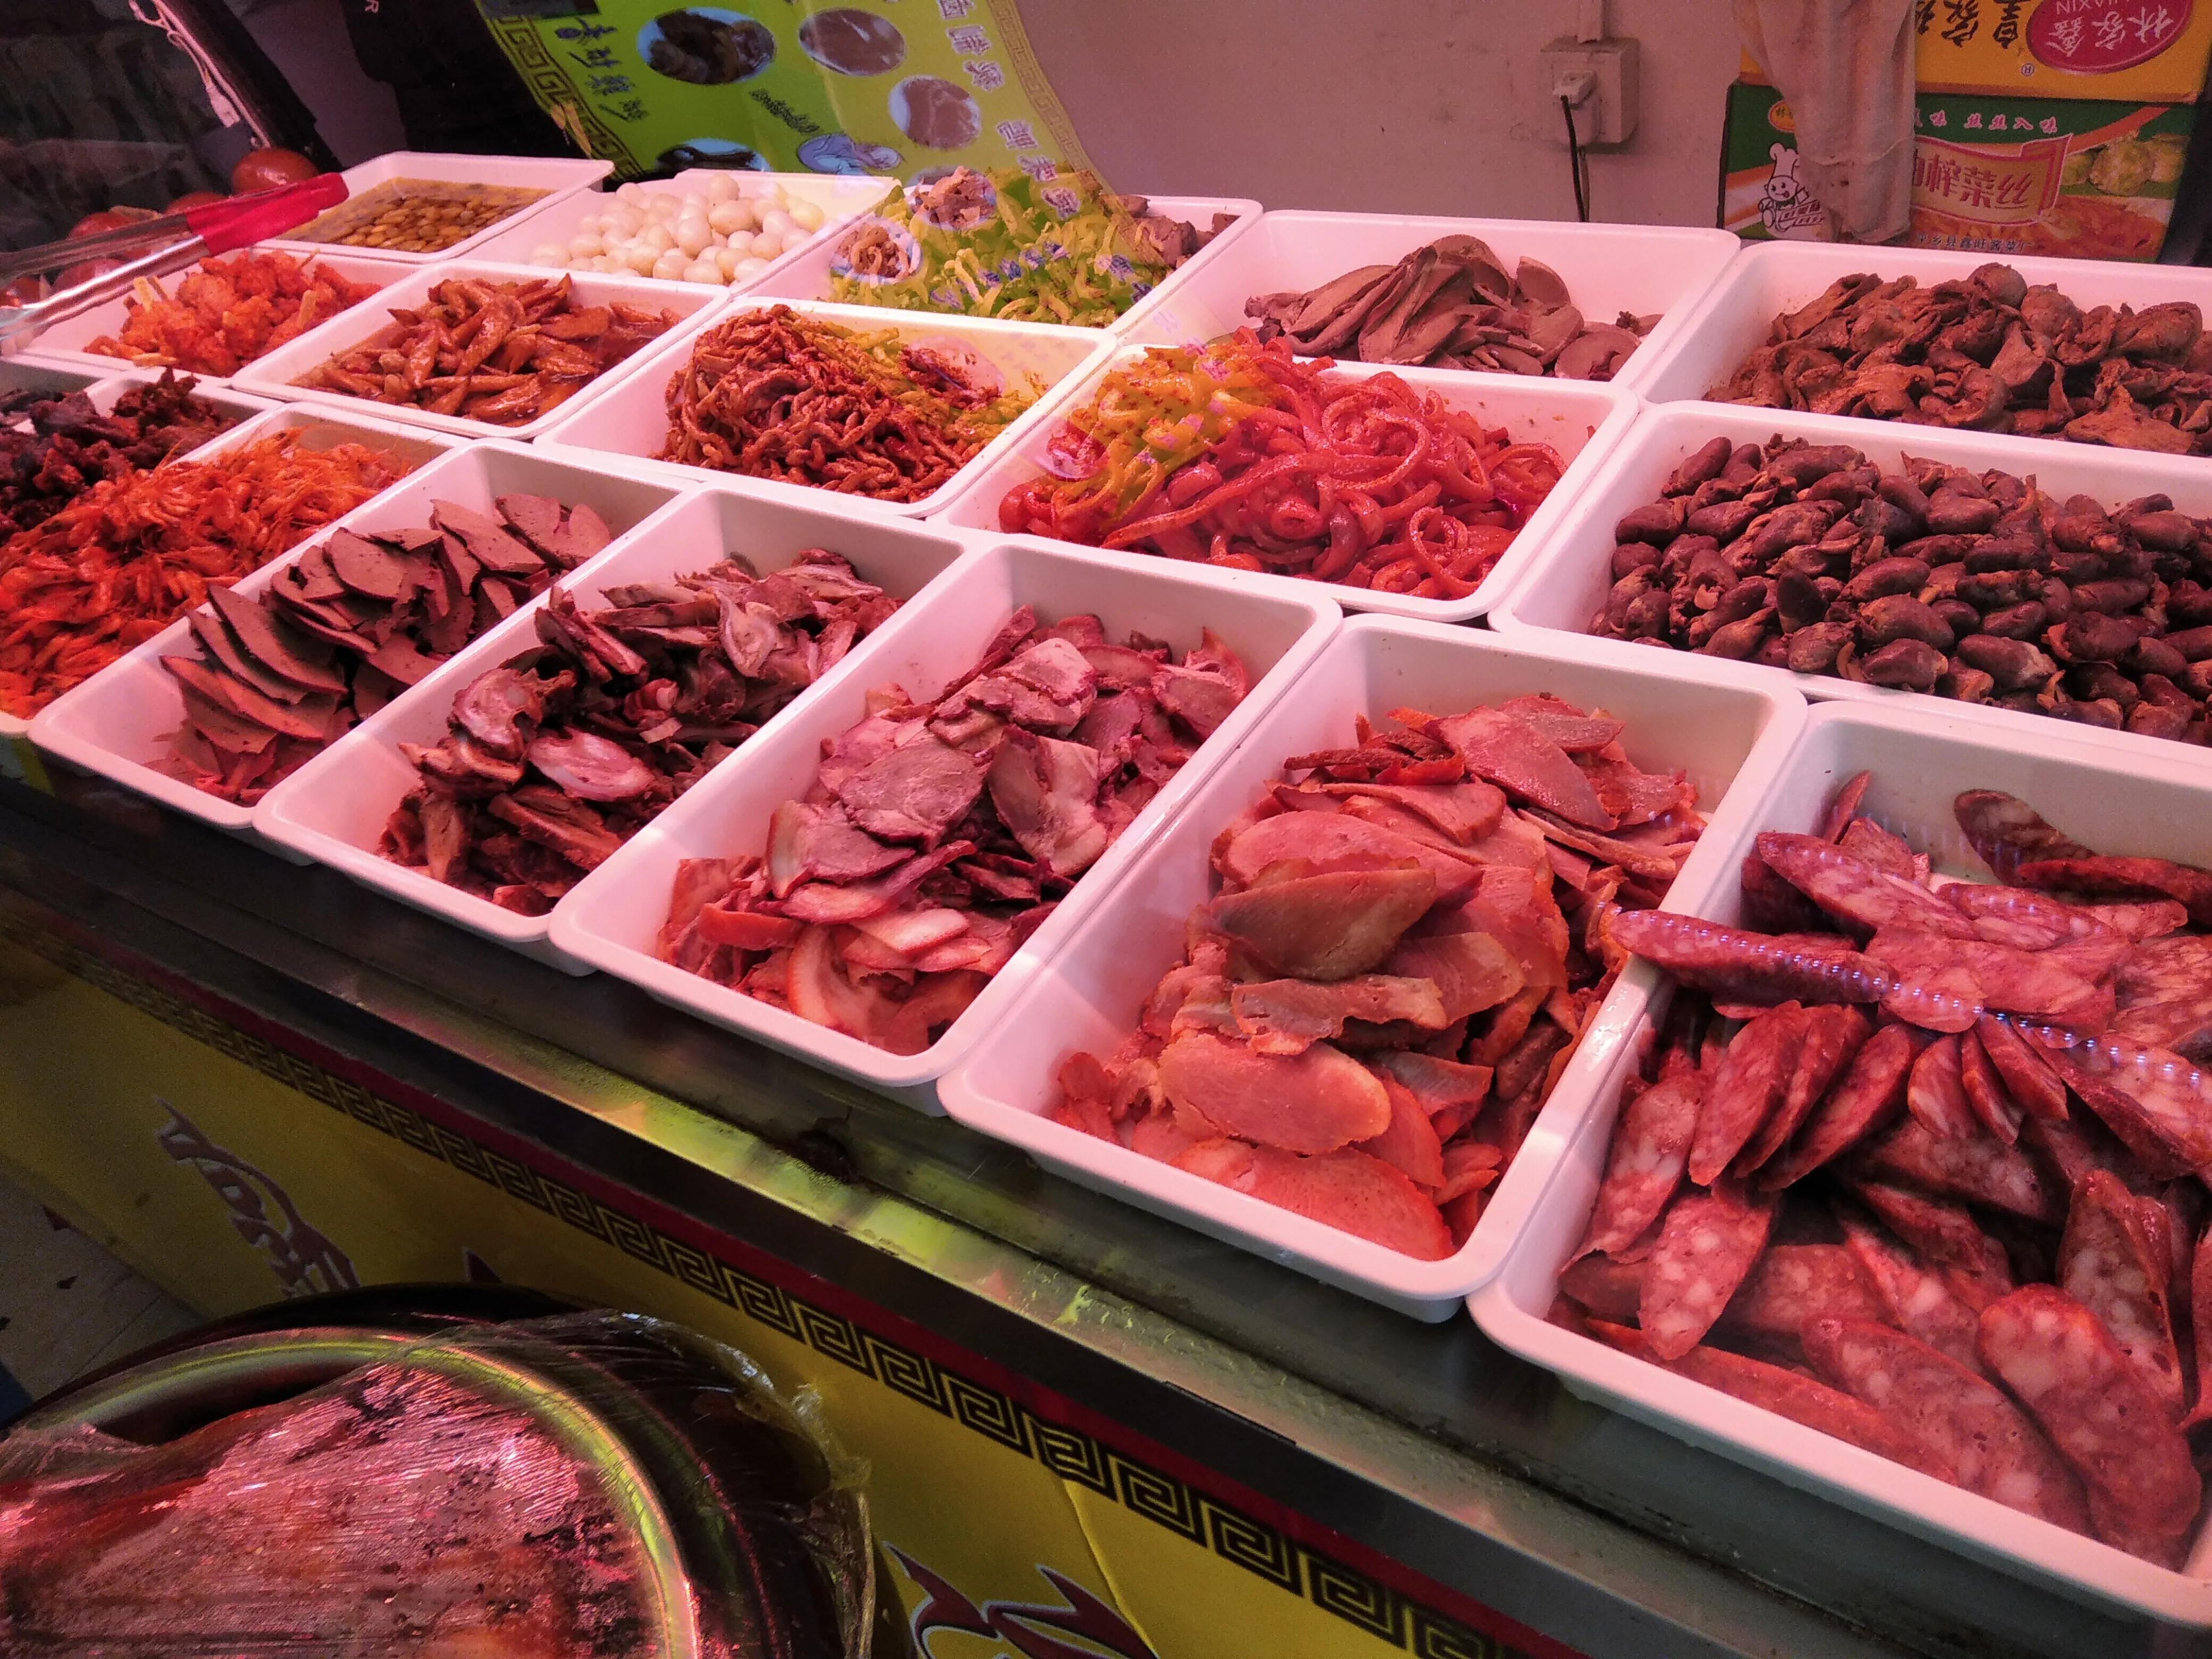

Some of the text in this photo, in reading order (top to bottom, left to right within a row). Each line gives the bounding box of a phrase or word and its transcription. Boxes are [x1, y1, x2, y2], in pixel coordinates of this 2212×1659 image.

[1916, 0, 2032, 50] 皇家
[2046, 4, 2174, 58] 林家鑫
[1963, 112, 2058, 134] 丝丝入味
